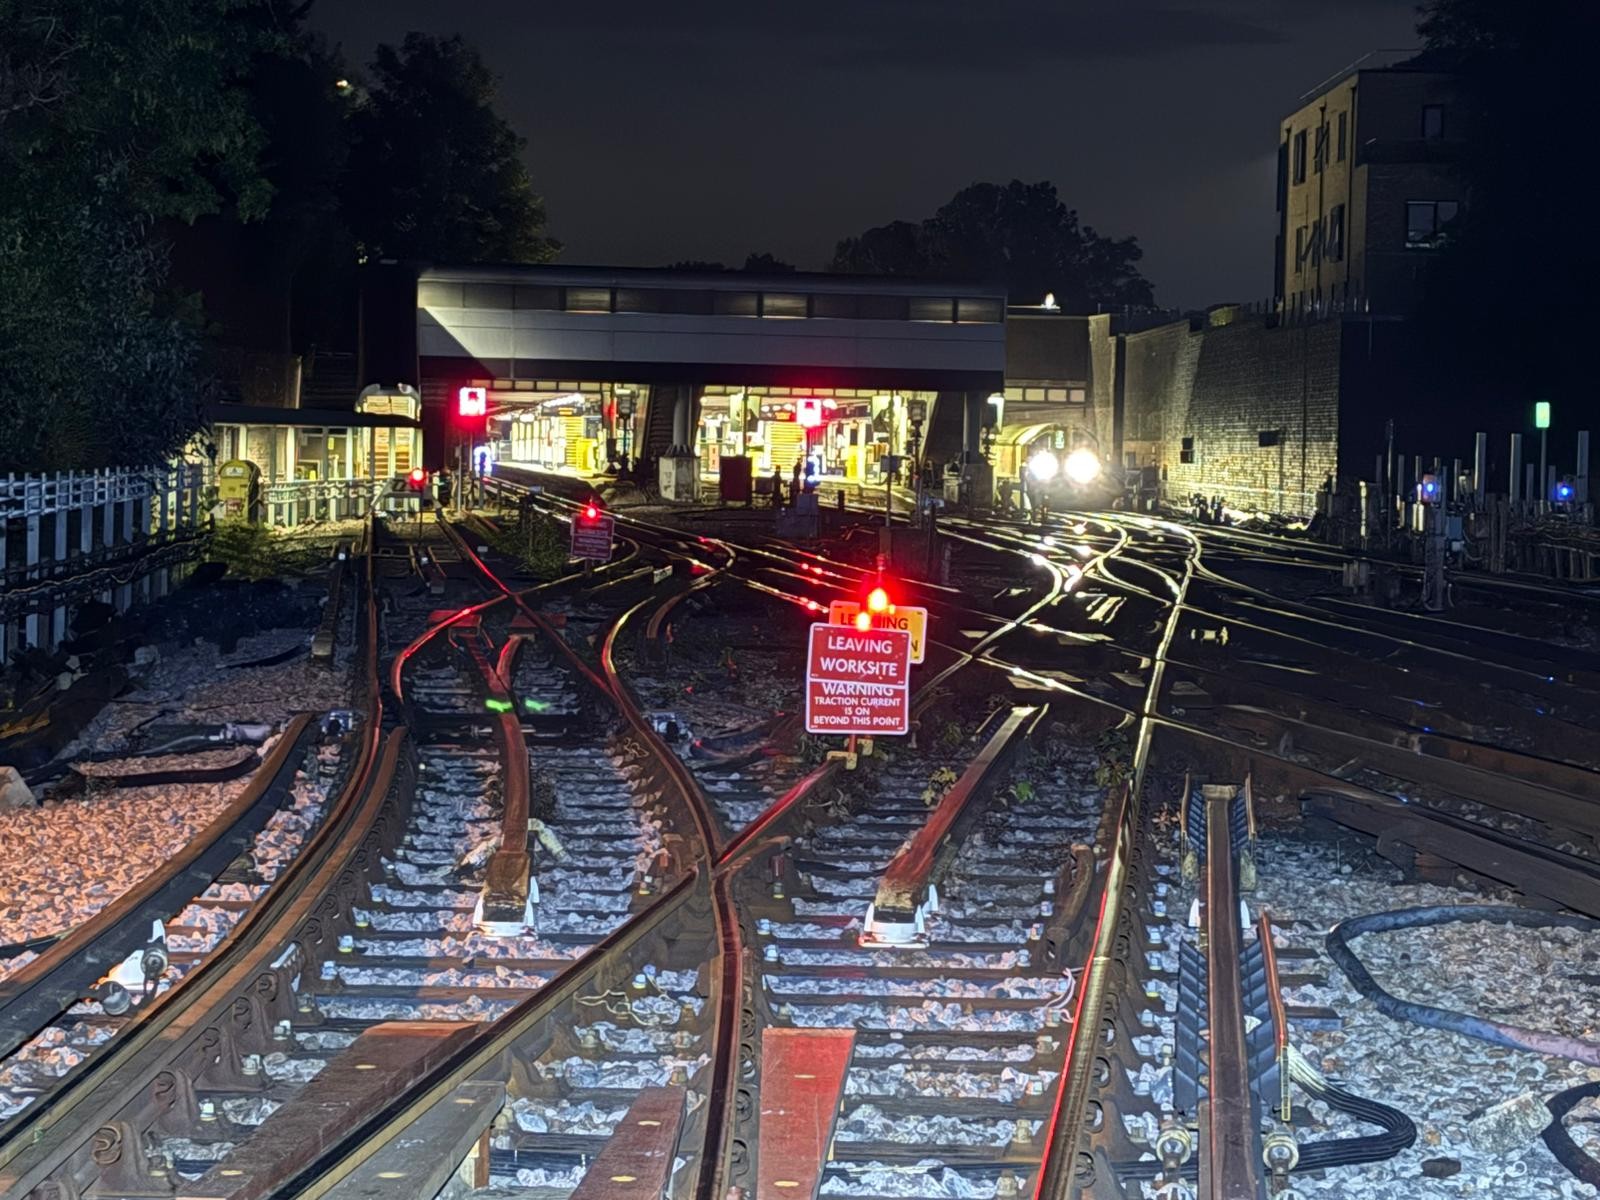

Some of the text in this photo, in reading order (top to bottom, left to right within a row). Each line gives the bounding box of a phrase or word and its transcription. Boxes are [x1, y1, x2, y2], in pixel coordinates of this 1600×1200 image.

[840, 612, 909, 630] LEING
[828, 635, 893, 654] LEAVING
[820, 656, 898, 676] WORKSITE
[822, 682, 894, 697] WARNING
[815, 696, 901, 707] TRACTION CURRENT
[844, 706, 870, 716] IS ON
[814, 716, 900, 726] BEYOND THIS POINT
